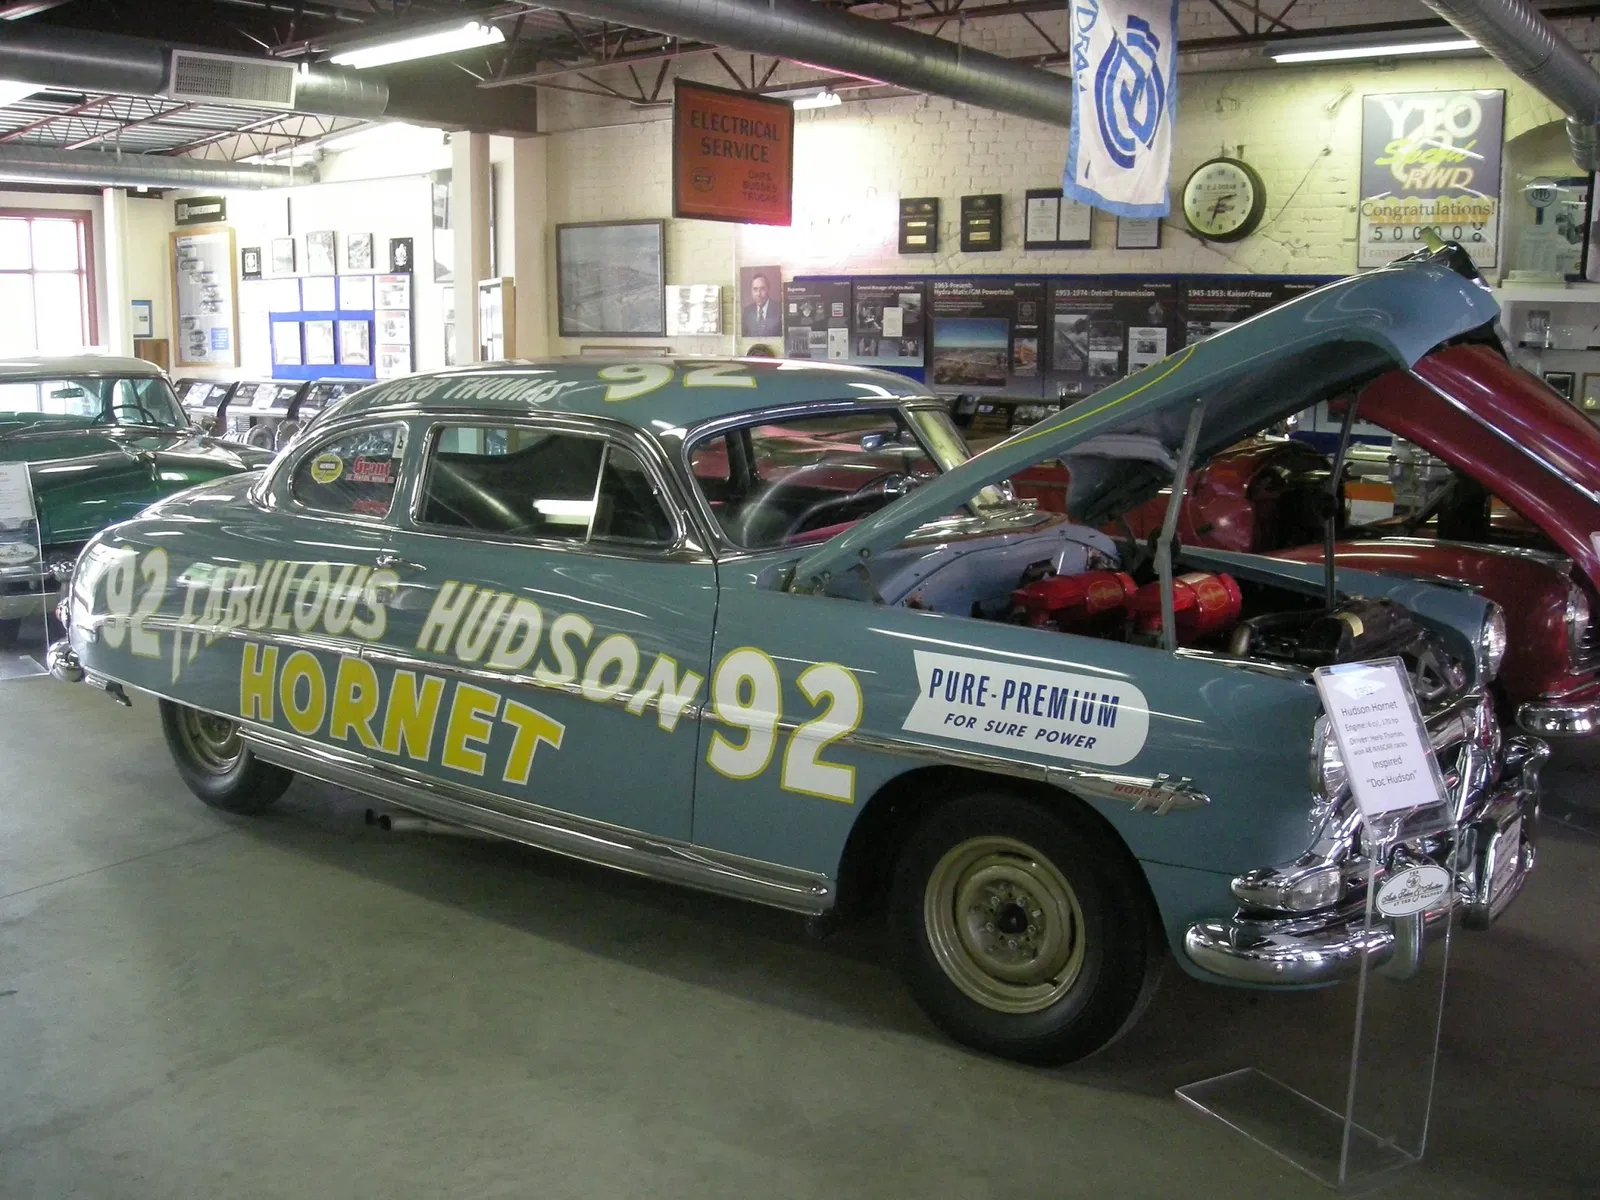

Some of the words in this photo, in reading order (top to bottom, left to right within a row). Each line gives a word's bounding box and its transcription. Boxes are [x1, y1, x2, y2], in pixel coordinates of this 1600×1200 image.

[690, 110, 781, 142] ELECTRICAL
[1381, 96, 1482, 138] YTO
[701, 136, 769, 163] SERVICE
[1403, 167, 1475, 191] RWD
[1361, 200, 1496, 220] Congratulations!
[1091, 289, 1113, 297] Detroit
[1114, 289, 1156, 297] Transmission
[1188, 289, 1226, 297] 1945-1953:
[1227, 290, 1273, 298] Kaiser/Frazer
[371, 377, 452, 403] HERB
[442, 377, 579, 403] THOMAS
[597, 362, 757, 401] 92
[103, 545, 168, 659] 92
[171, 560, 400, 685] FABULOUS
[416, 580, 704, 732] HUDSON
[240, 642, 566, 786] HORNET
[929, 668, 1120, 729] PURE-PREMIUM
[1340, 704, 1371, 717] Hudson
[1371, 701, 1399, 712] Hornet
[706, 646, 863, 804] 92
[943, 712, 977, 729] FOR
[983, 719, 1028, 738] SURE
[1035, 728, 1097, 750] POWER
[1371, 755, 1403, 769] Inspired
